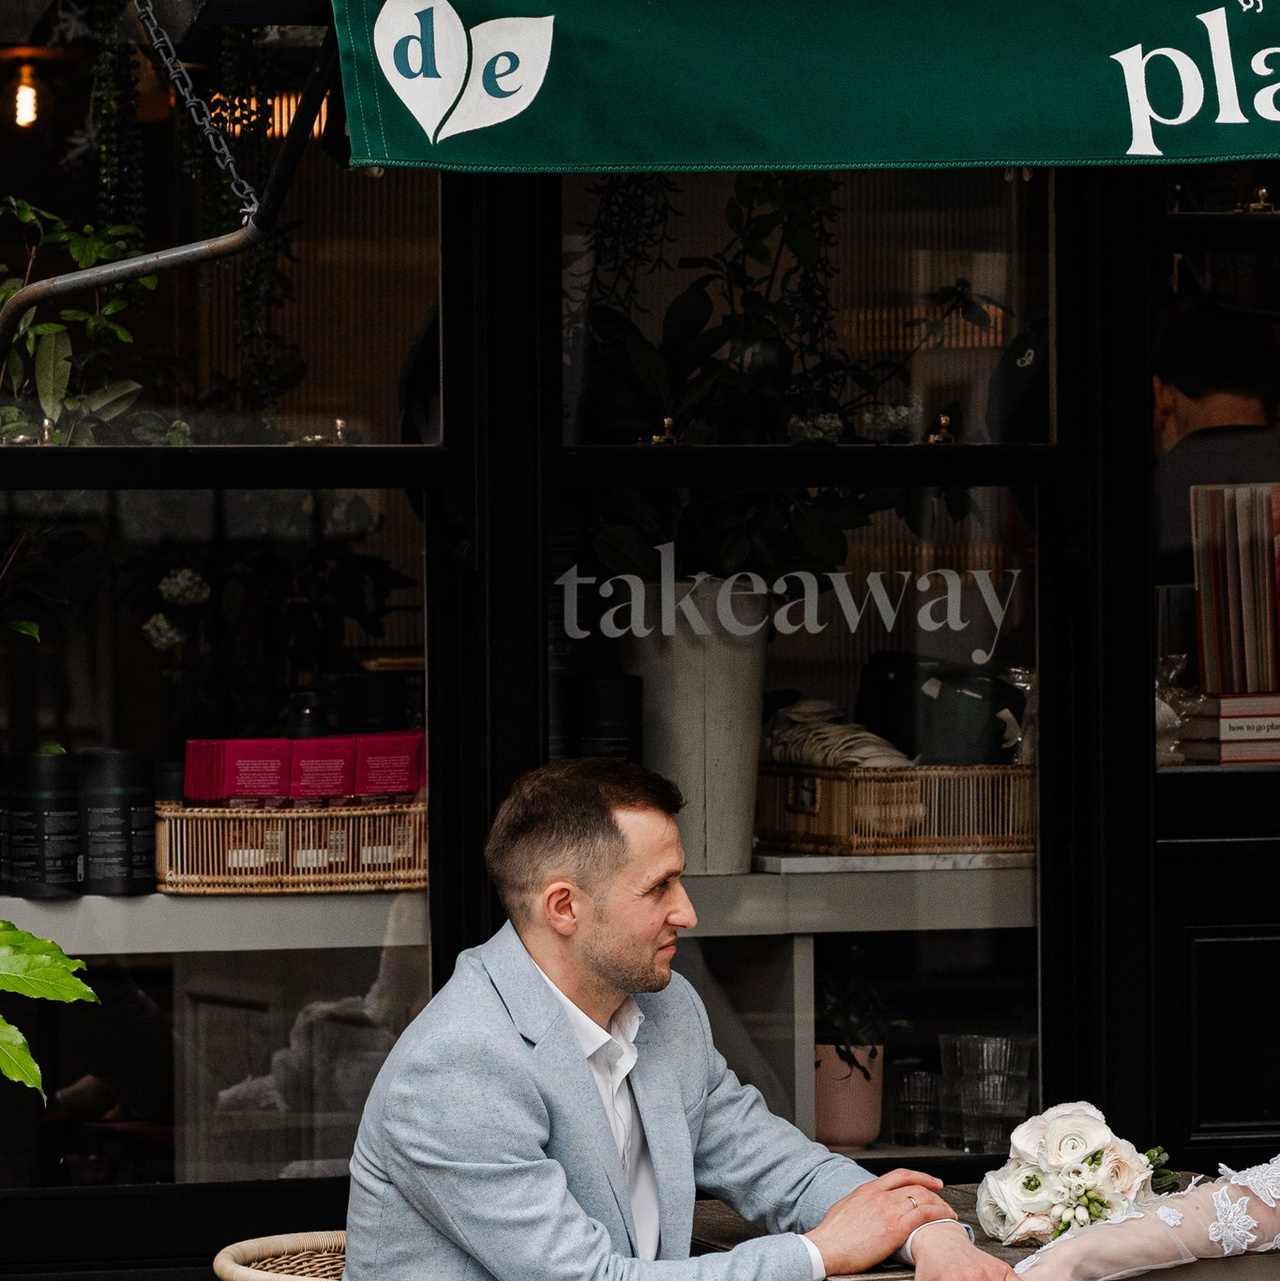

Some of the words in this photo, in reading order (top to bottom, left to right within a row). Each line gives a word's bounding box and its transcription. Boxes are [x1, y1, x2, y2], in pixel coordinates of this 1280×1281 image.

[554, 541, 1021, 665] takeaway
[1228, 723, 1245, 732] how
[1256, 725, 1266, 733] go
